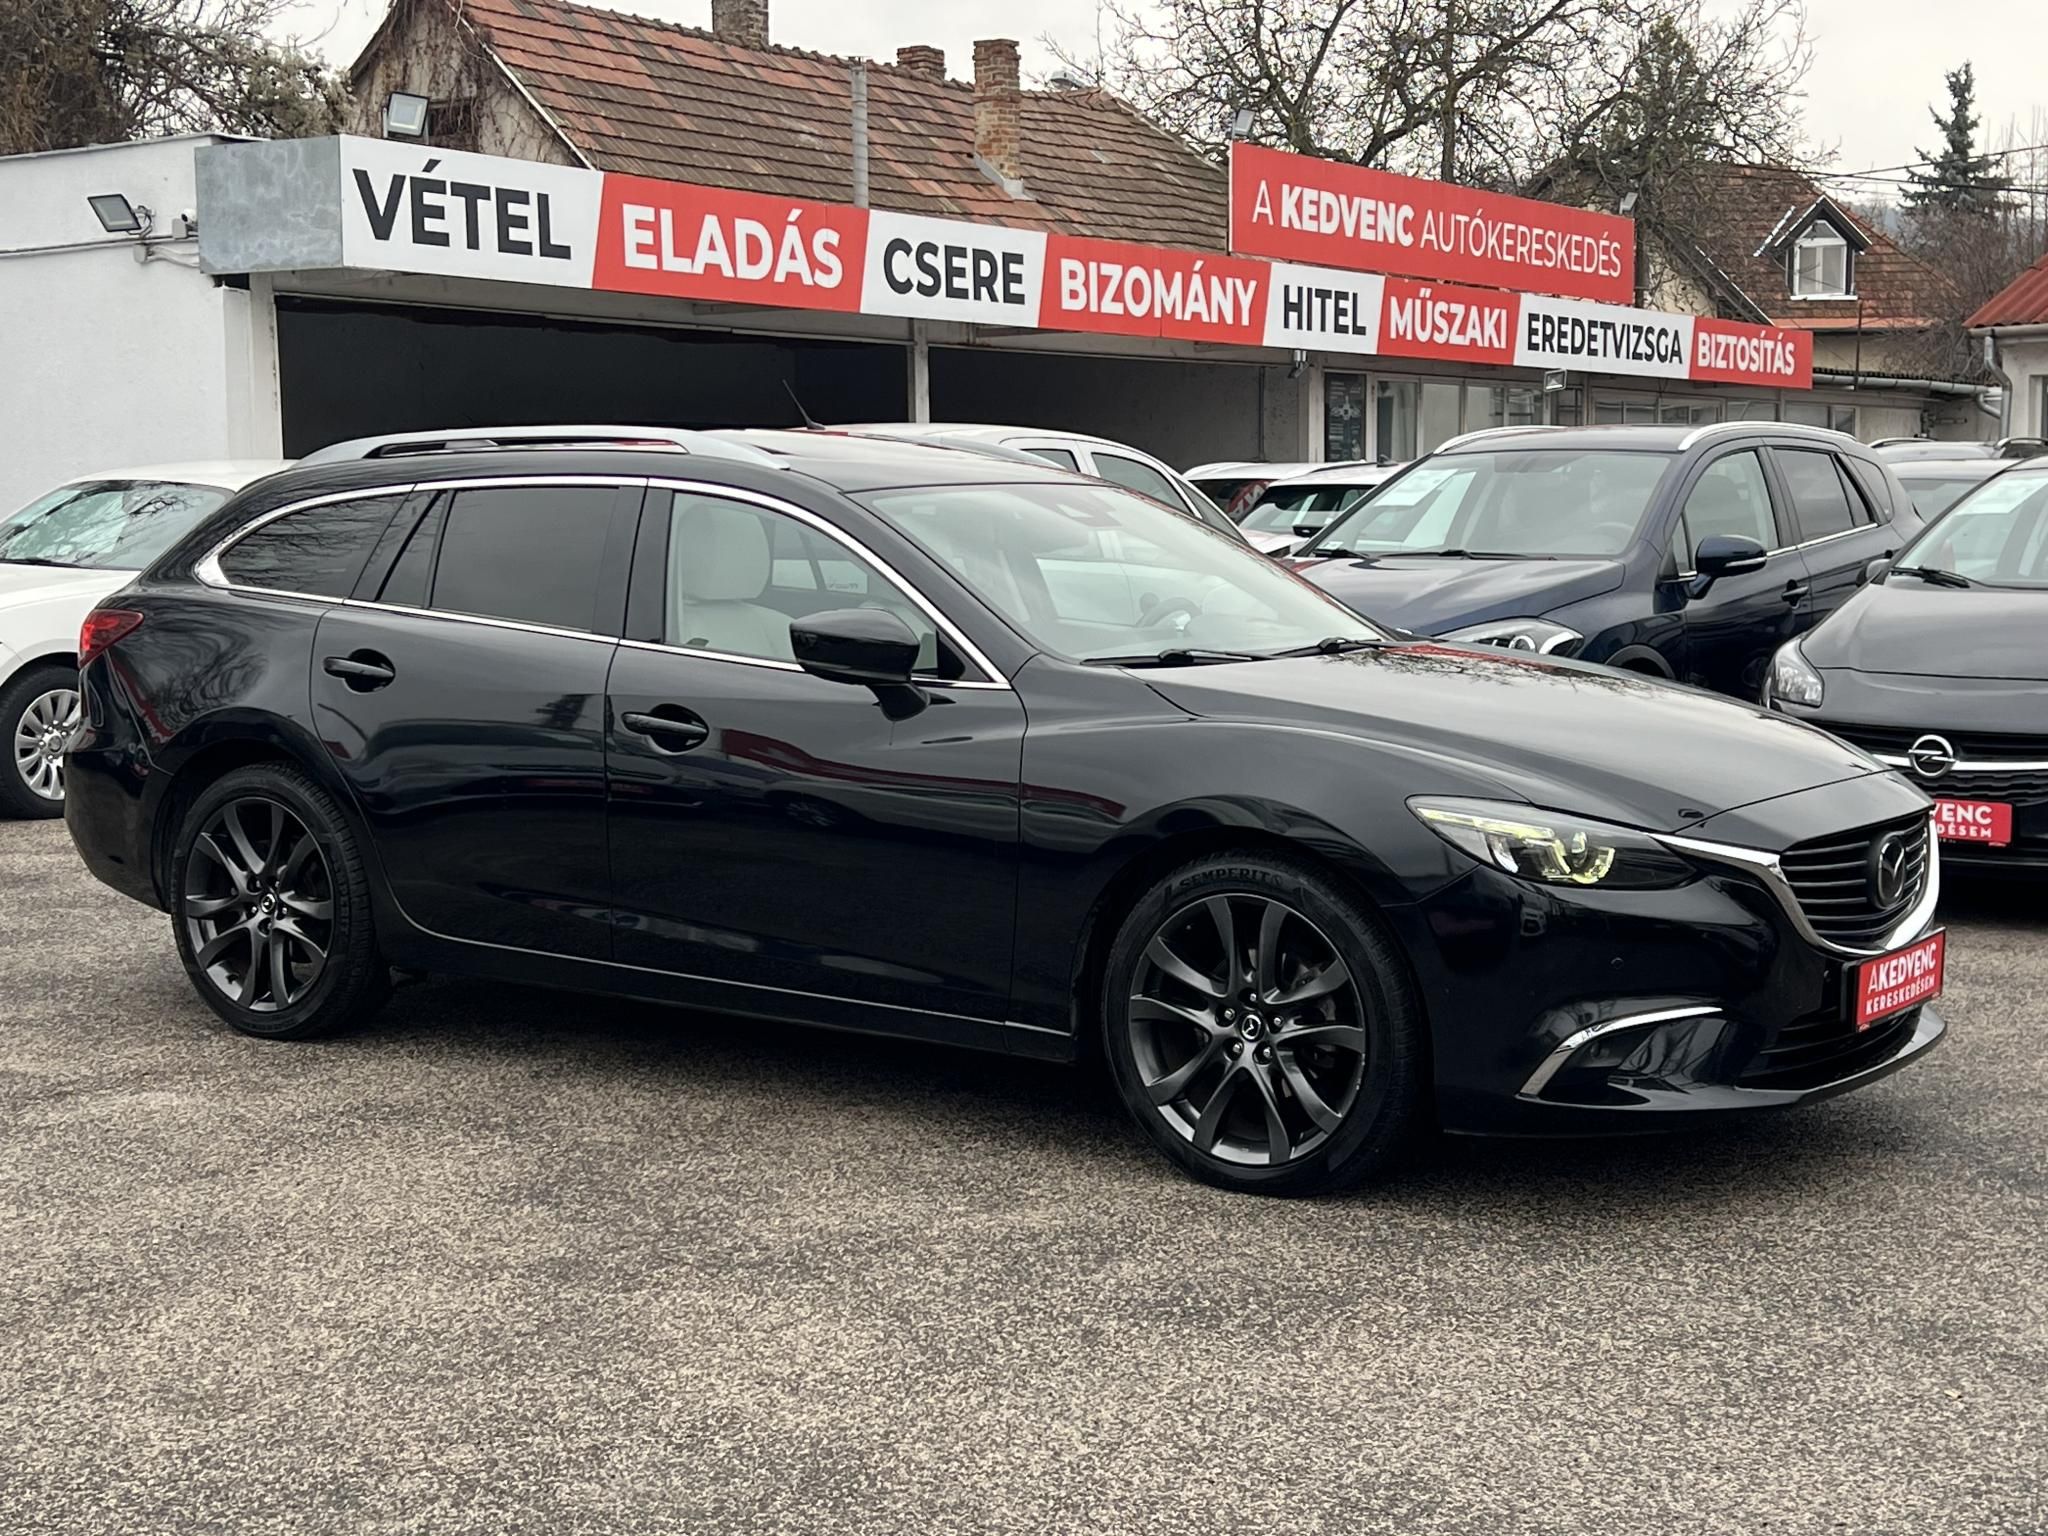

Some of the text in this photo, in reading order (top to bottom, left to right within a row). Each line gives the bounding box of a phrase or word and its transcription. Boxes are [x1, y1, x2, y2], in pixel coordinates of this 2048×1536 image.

[352, 159, 572, 260] VÉTEL
[1252, 179, 1621, 278] A KEDVENC AUTÓKERESKEDÉS
[622, 203, 844, 289] ELADÁS
[883, 237, 1026, 305] CSERE
[1060, 258, 1258, 326] BIZOMÁNY
[1283, 284, 1367, 336] HITEL
[1390, 286, 1507, 349] MŰSZAKI
[1527, 312, 1683, 365] EREDETVIZSGA
[1698, 330, 1795, 376] BIZTOSÍTÁS
[1179, 867, 1271, 888] SEMPERIT
[1865, 973, 1936, 1016] KERESKEDÉSEM
